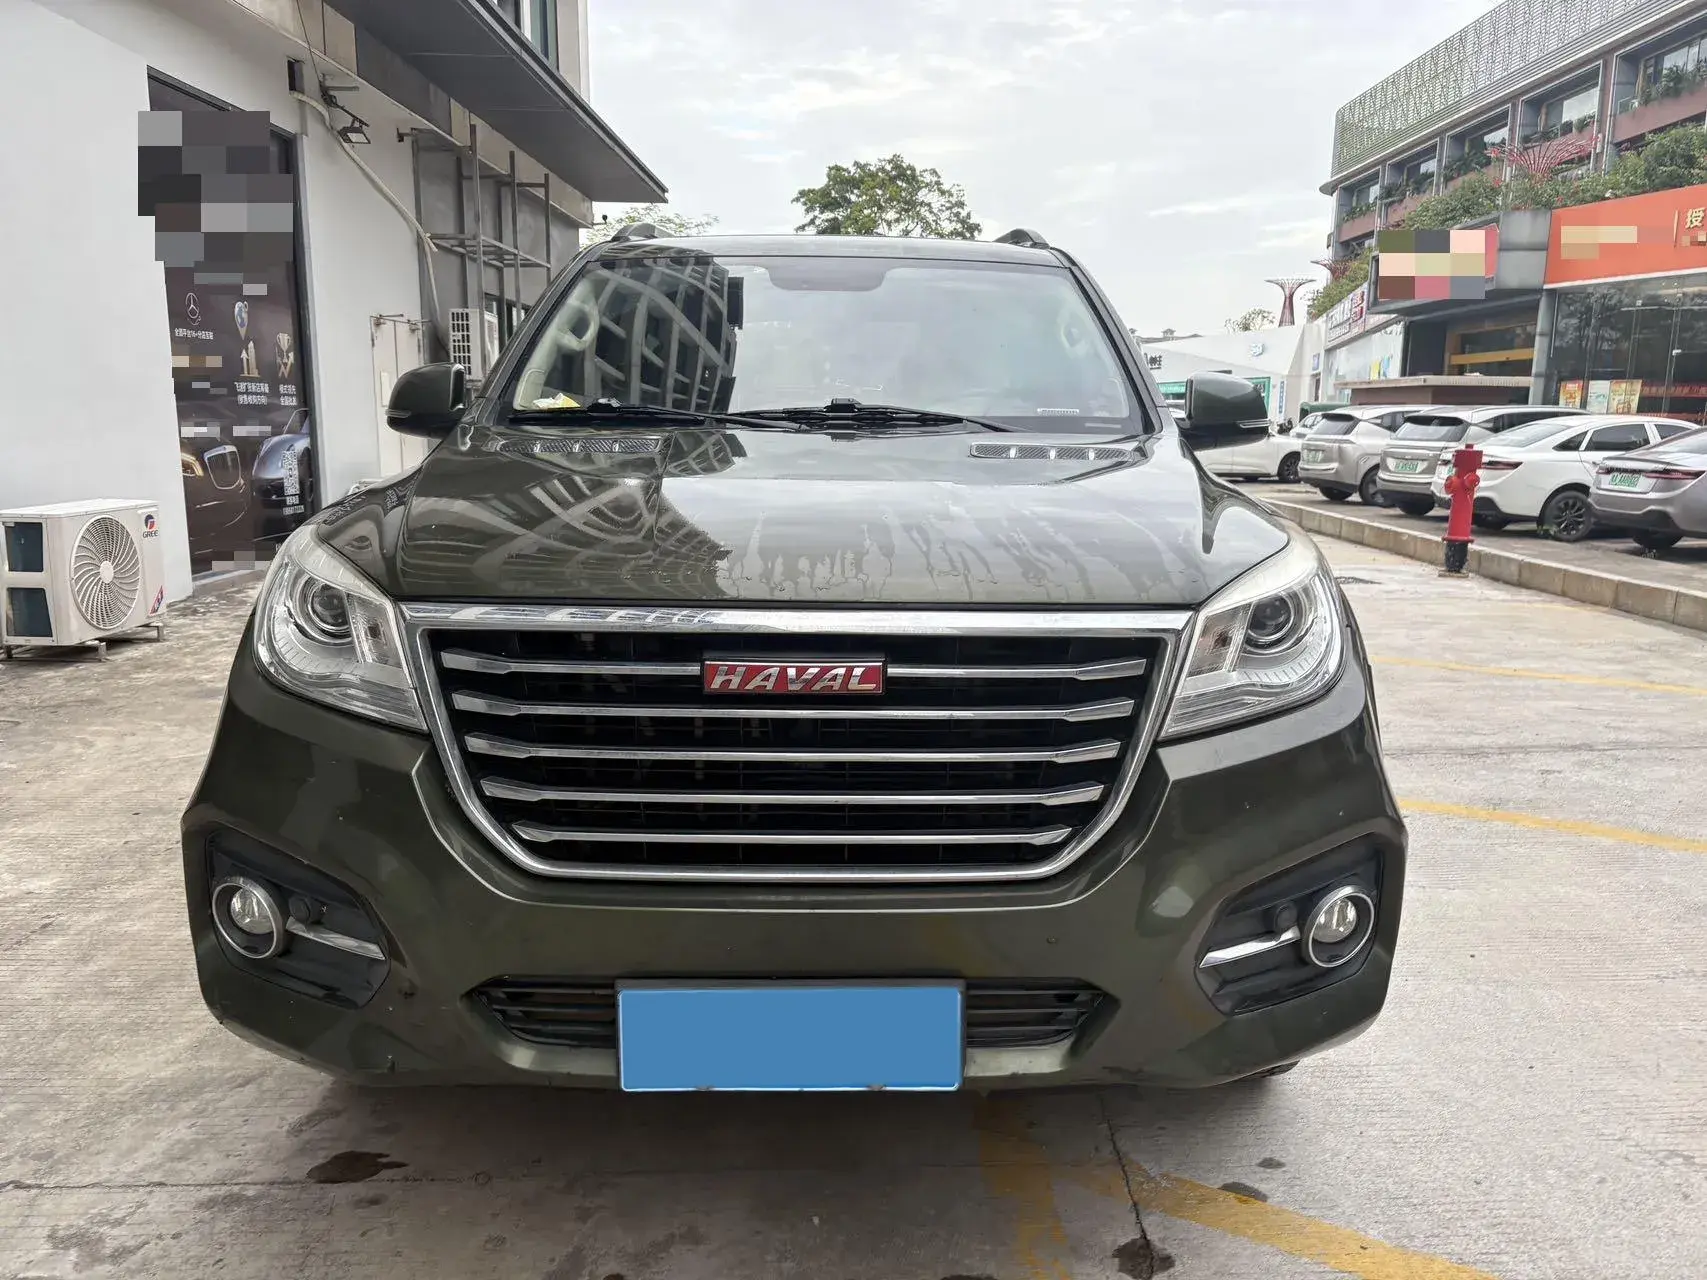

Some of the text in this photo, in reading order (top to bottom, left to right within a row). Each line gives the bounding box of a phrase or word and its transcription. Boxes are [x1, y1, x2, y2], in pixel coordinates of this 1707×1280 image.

[1685, 207, 1705, 229] 授
[142, 529, 159, 538] GREE
[710, 666, 877, 691] HAVAL
